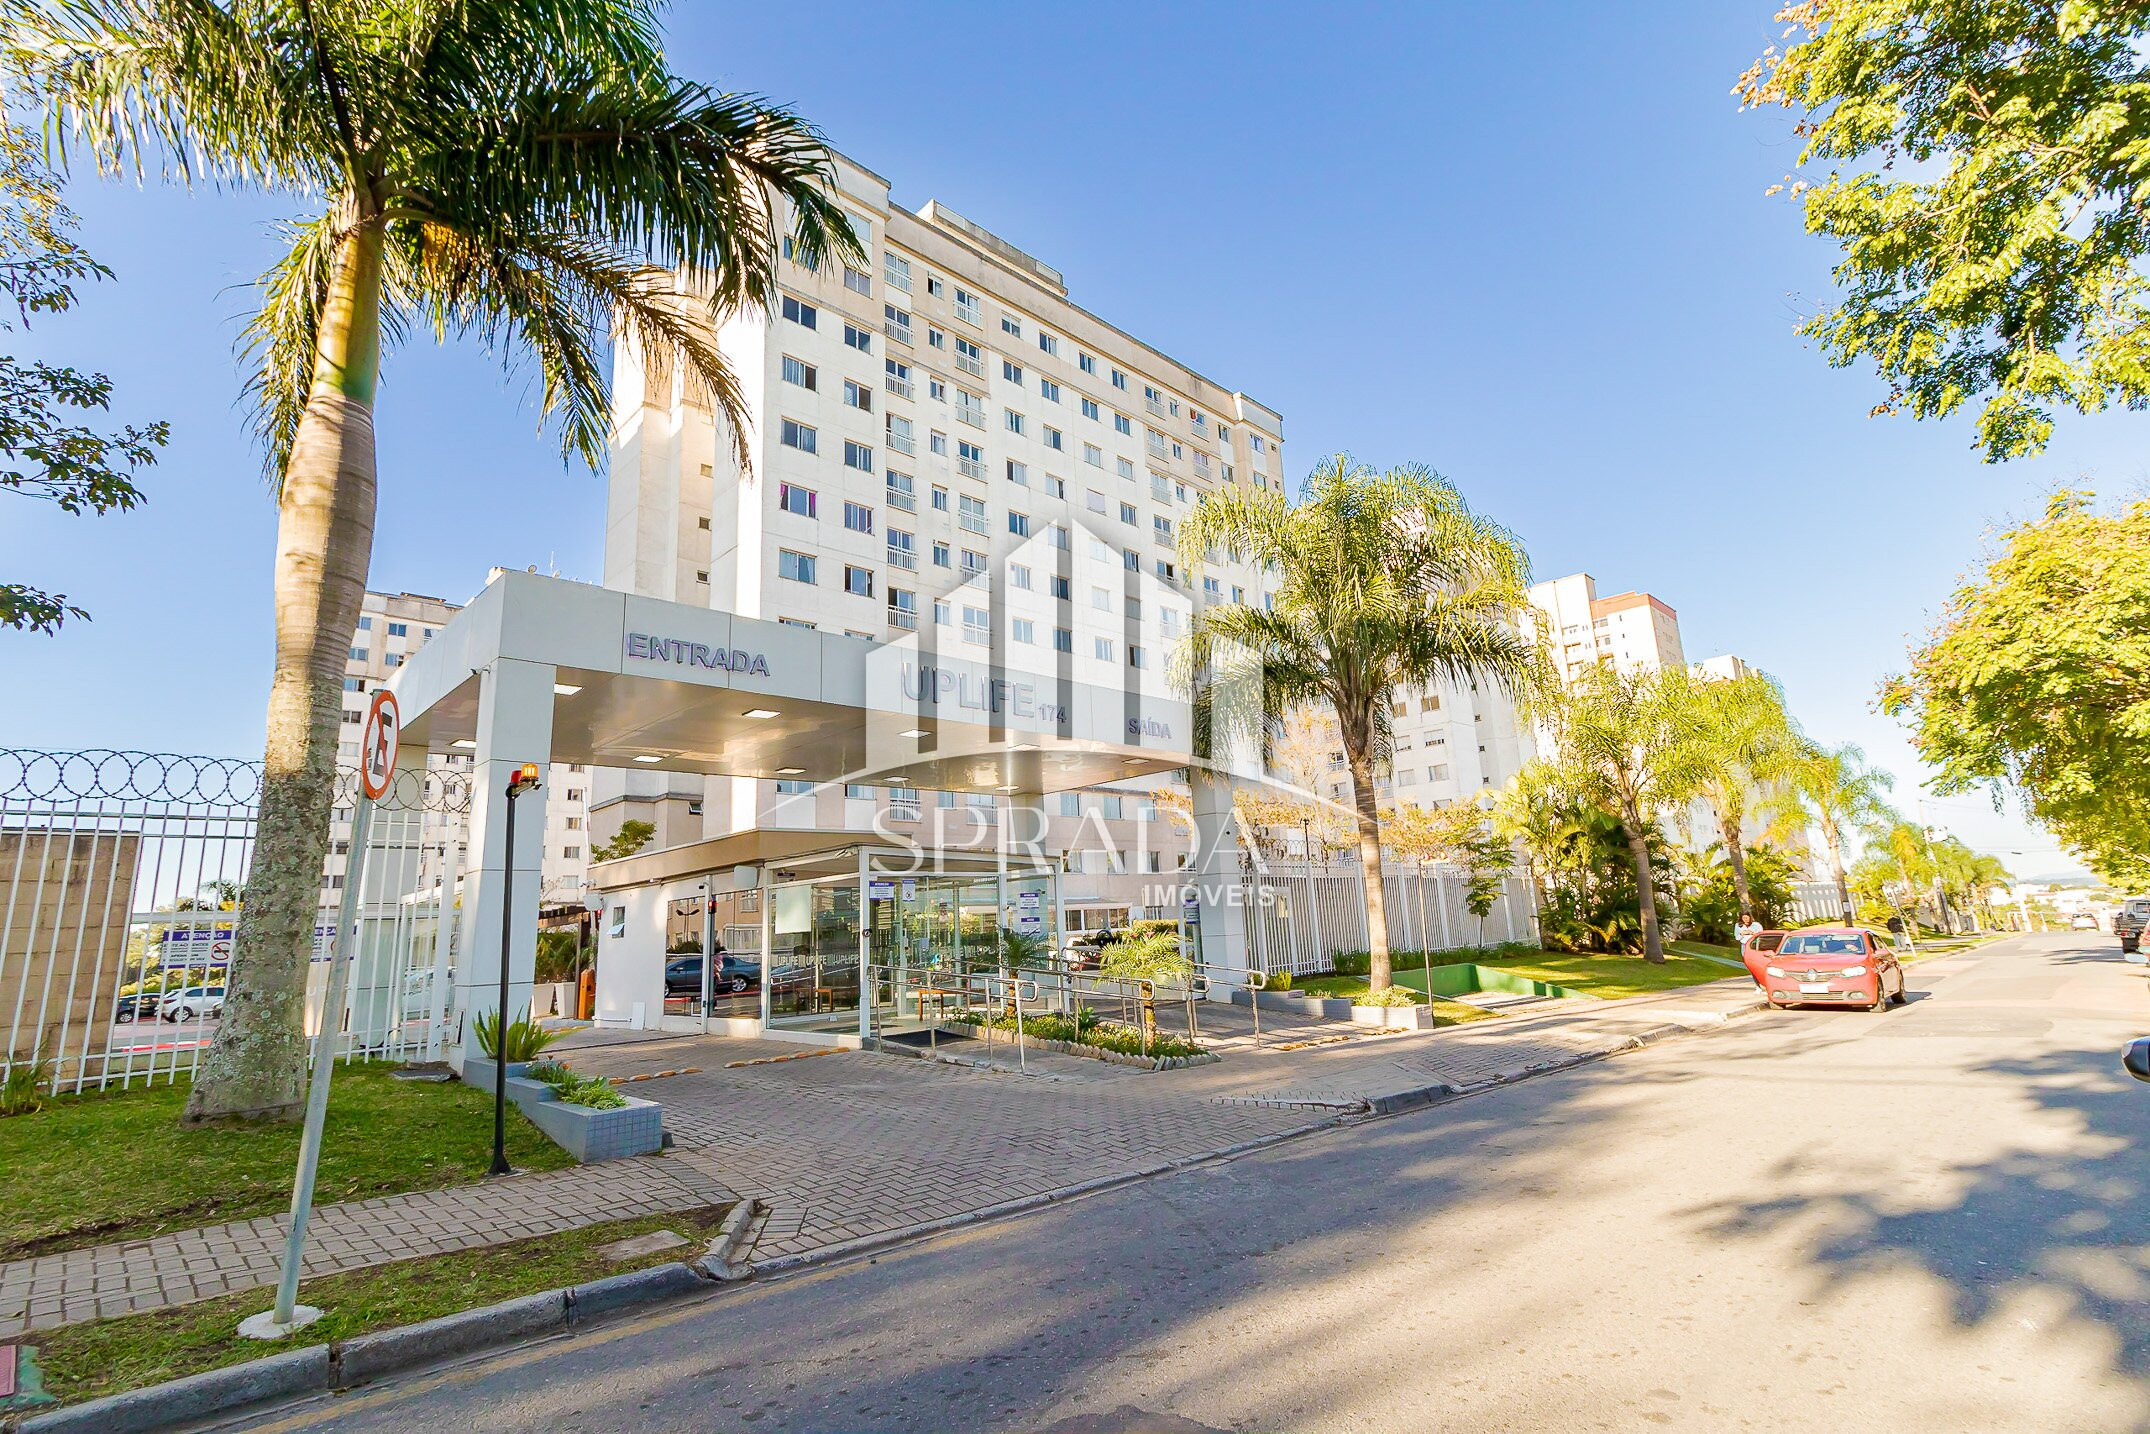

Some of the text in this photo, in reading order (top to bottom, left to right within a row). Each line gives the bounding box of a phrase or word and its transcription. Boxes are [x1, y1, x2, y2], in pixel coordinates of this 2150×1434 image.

[628, 632, 771, 677] ENTRADA
[902, 661, 1068, 724] UPLIFE 174
[1128, 716, 1173, 740] SAÍDA
